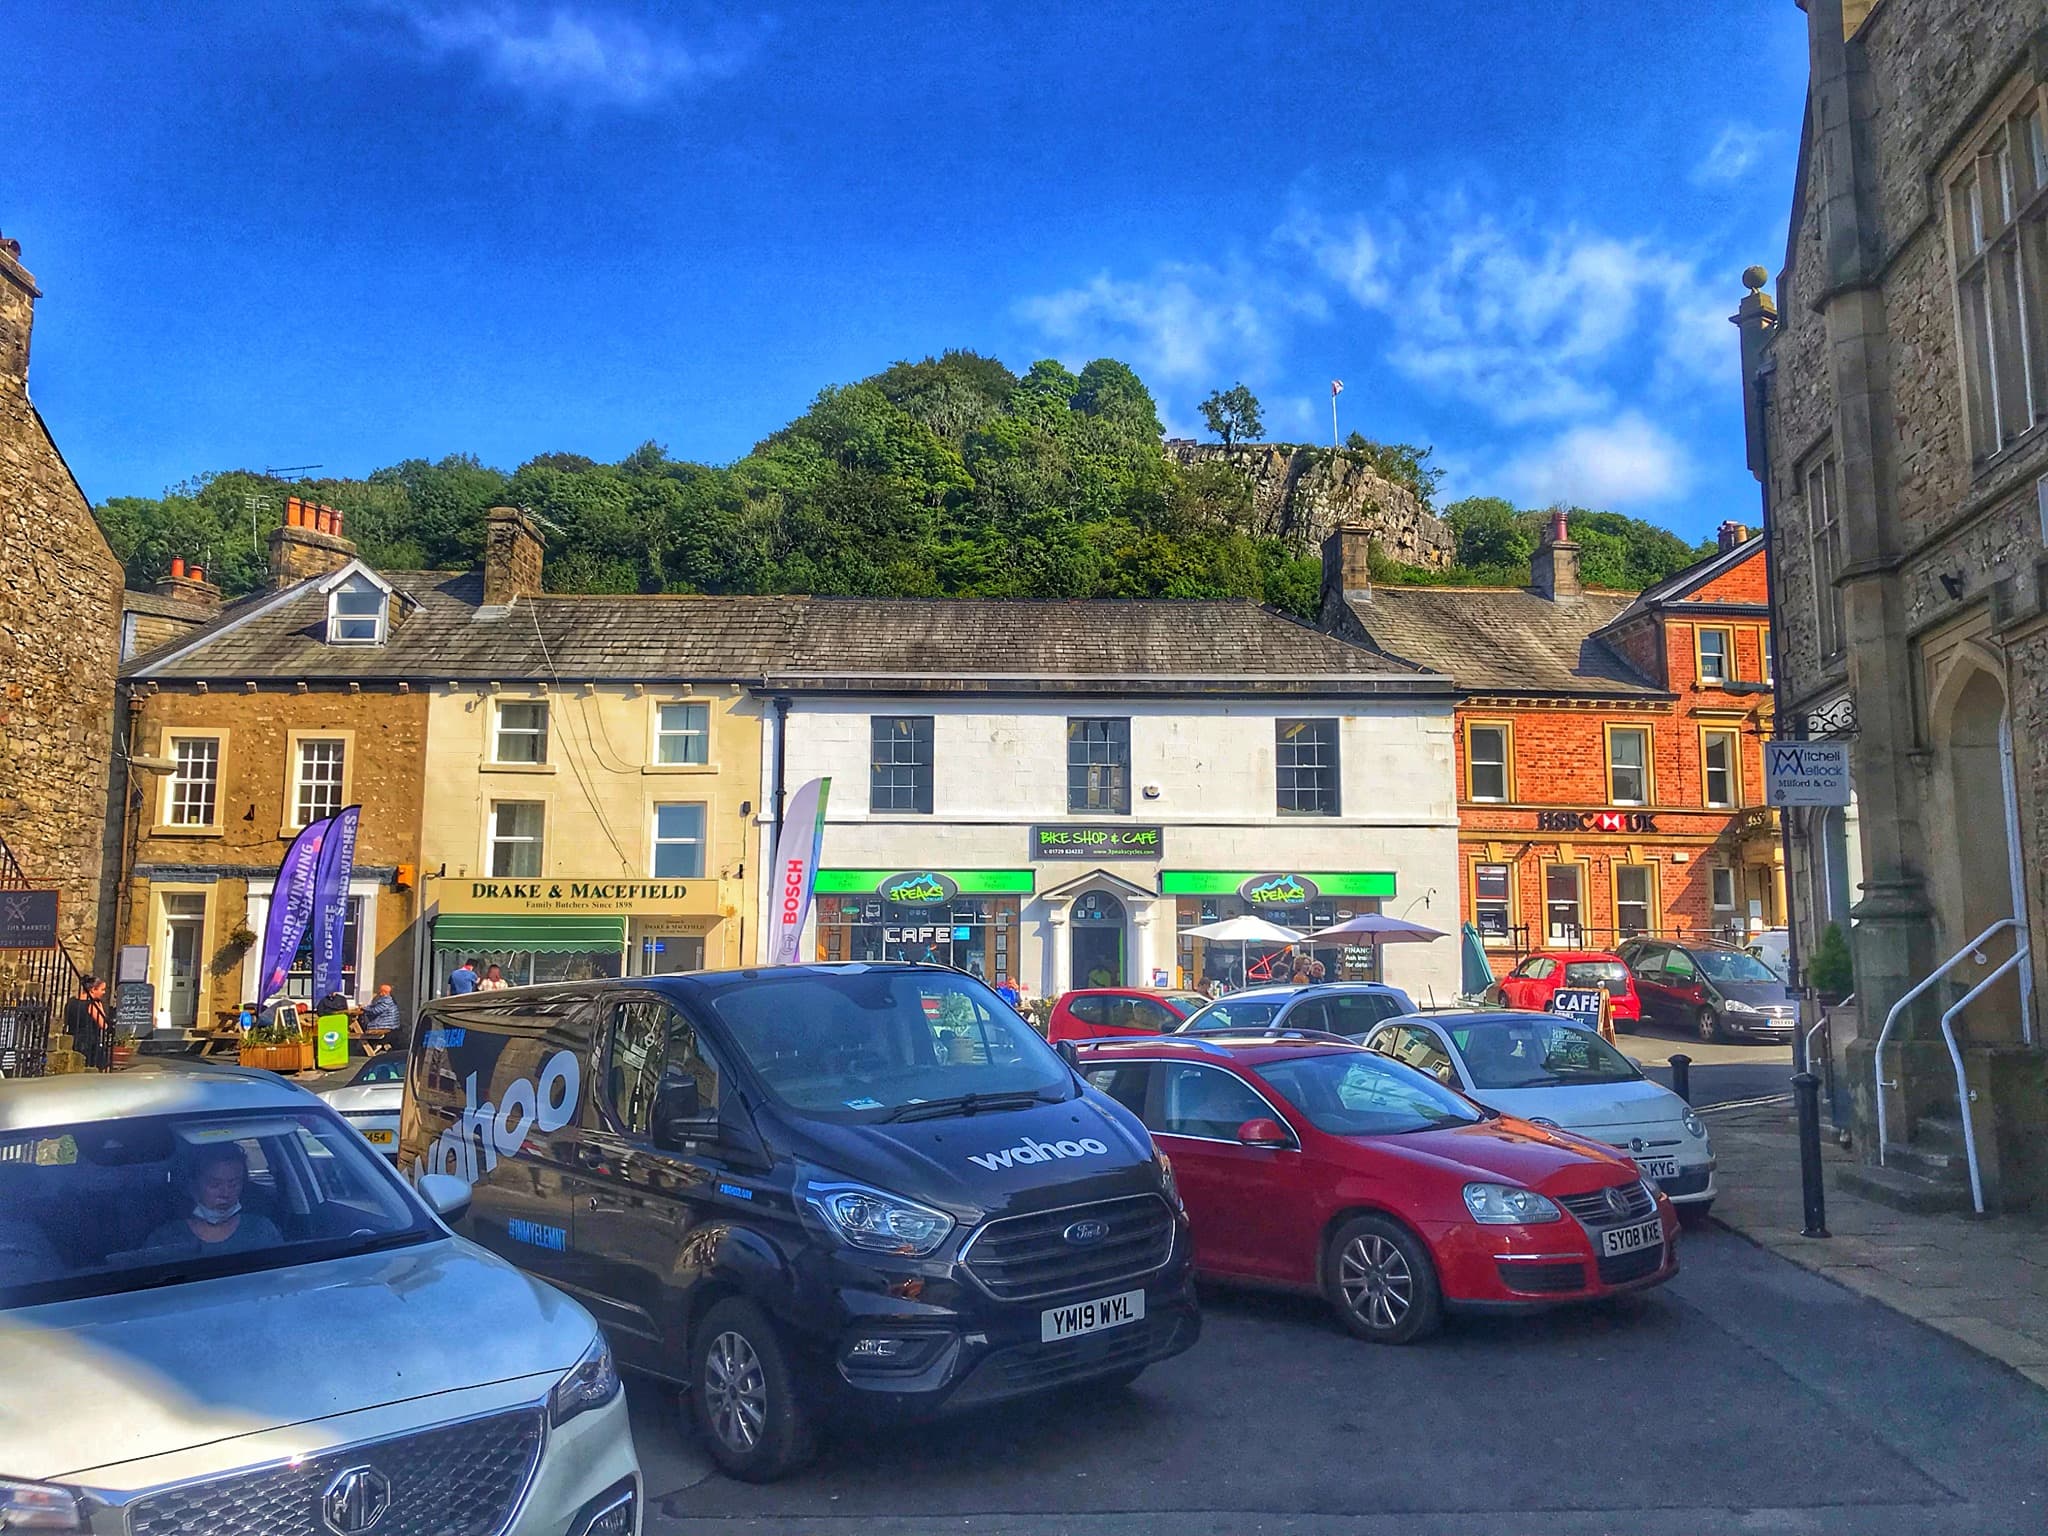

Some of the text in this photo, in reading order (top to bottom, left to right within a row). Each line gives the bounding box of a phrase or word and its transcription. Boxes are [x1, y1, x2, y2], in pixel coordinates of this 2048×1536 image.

[1537, 810, 1658, 832] HSBC UK
[1040, 831, 1071, 845] BIKE
[1073, 830, 1107, 846] SHOP
[1122, 830, 1158, 845] CAFÉ
[336, 814, 357, 916] SANDWICHES
[287, 843, 314, 911] WINNING
[472, 883, 687, 899] DRAKE & MACEFIELD
[783, 860, 803, 924] BOSCH
[526, 901, 633, 910] Family Butchers Since 1898
[324, 904, 336, 959] COFFEE
[885, 927, 950, 943] CAFE
[316, 962, 329, 989] TEA
[1555, 992, 1600, 1012] CAFÉ
[363, 1132, 386, 1143] 454
[968, 1137, 1107, 1171] wahoo
[1649, 1162, 1675, 1177] KYG
[1076, 1223, 1102, 1239] Ford
[1608, 1229, 1641, 1251] SY08
[1053, 1296, 1134, 1335] YM19 WYL
